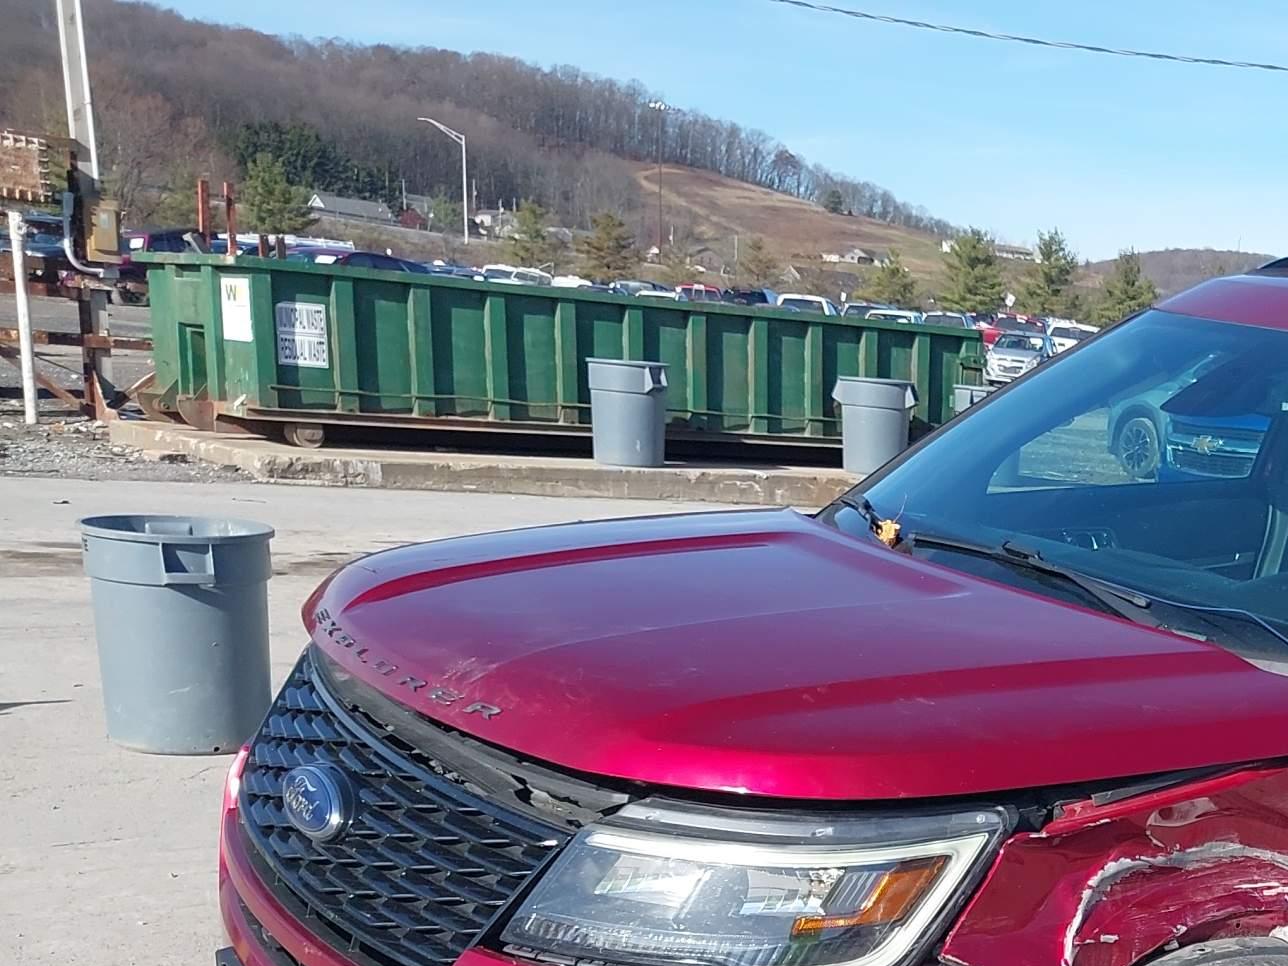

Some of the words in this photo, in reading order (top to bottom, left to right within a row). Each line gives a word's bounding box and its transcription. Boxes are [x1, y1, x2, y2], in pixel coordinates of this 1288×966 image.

[306, 309, 325, 331] WASTE
[280, 337, 308, 361] RESIDUAL
[308, 340, 327, 363] WASTE
[316, 608, 502, 720] EXPLORER
[286, 775, 320, 821] Ford
